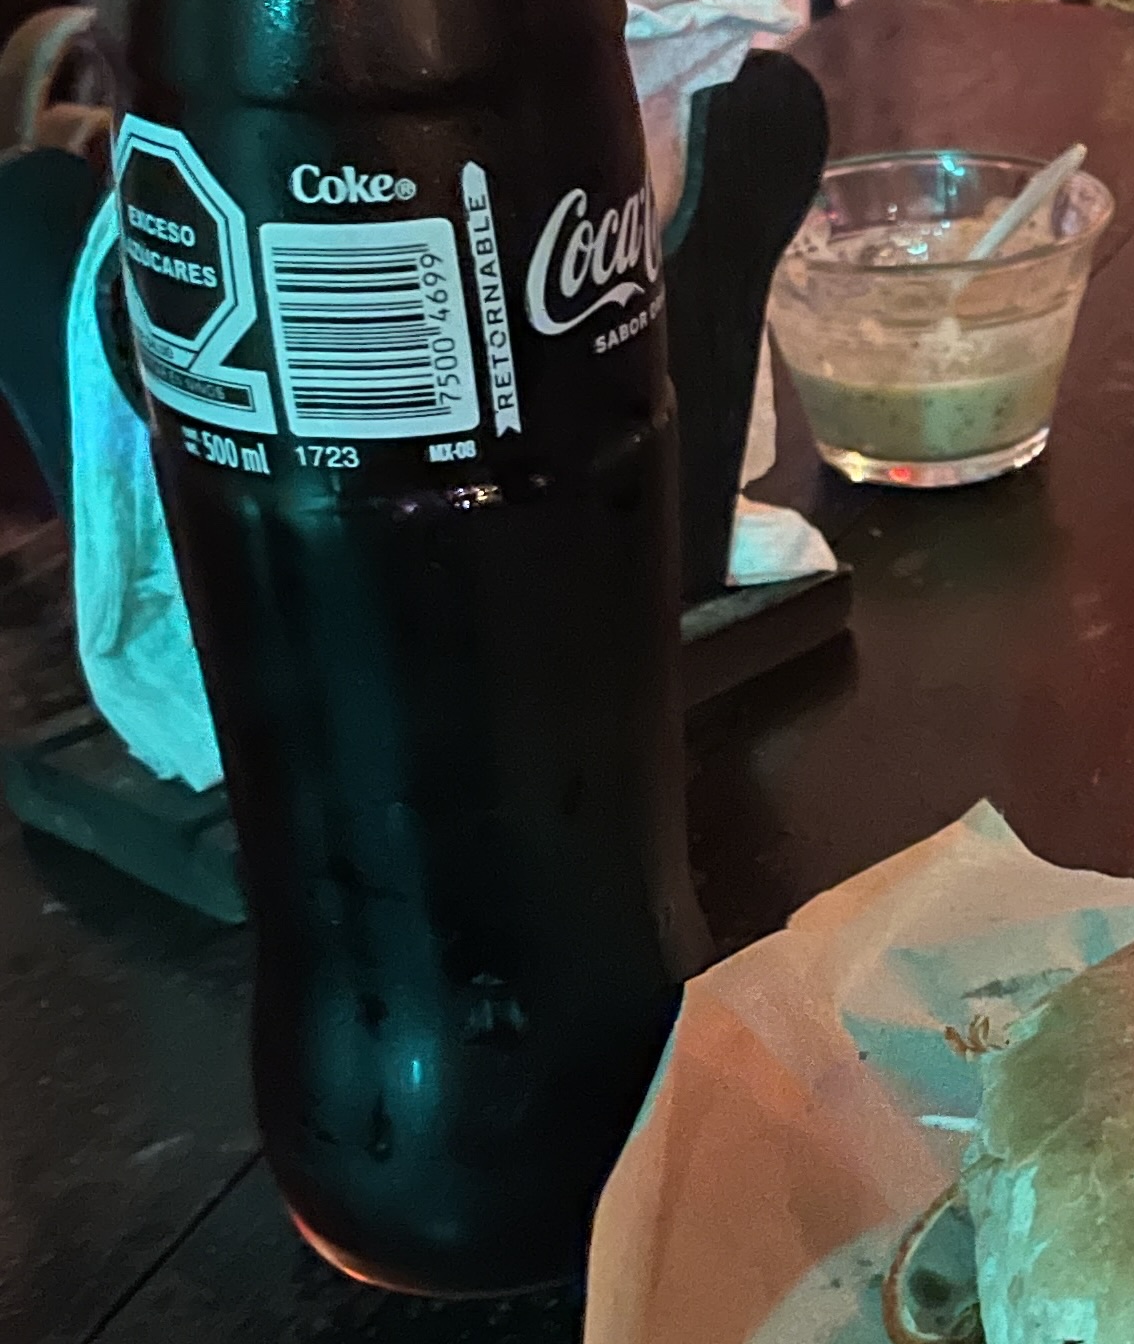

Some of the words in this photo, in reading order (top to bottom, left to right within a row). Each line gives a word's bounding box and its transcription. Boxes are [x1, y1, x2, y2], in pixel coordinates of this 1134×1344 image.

[468, 194, 516, 411] RETORNABLE
[593, 310, 649, 354] SABOR
[240, 442, 271, 476] ml
[294, 445, 360, 468] 1723
